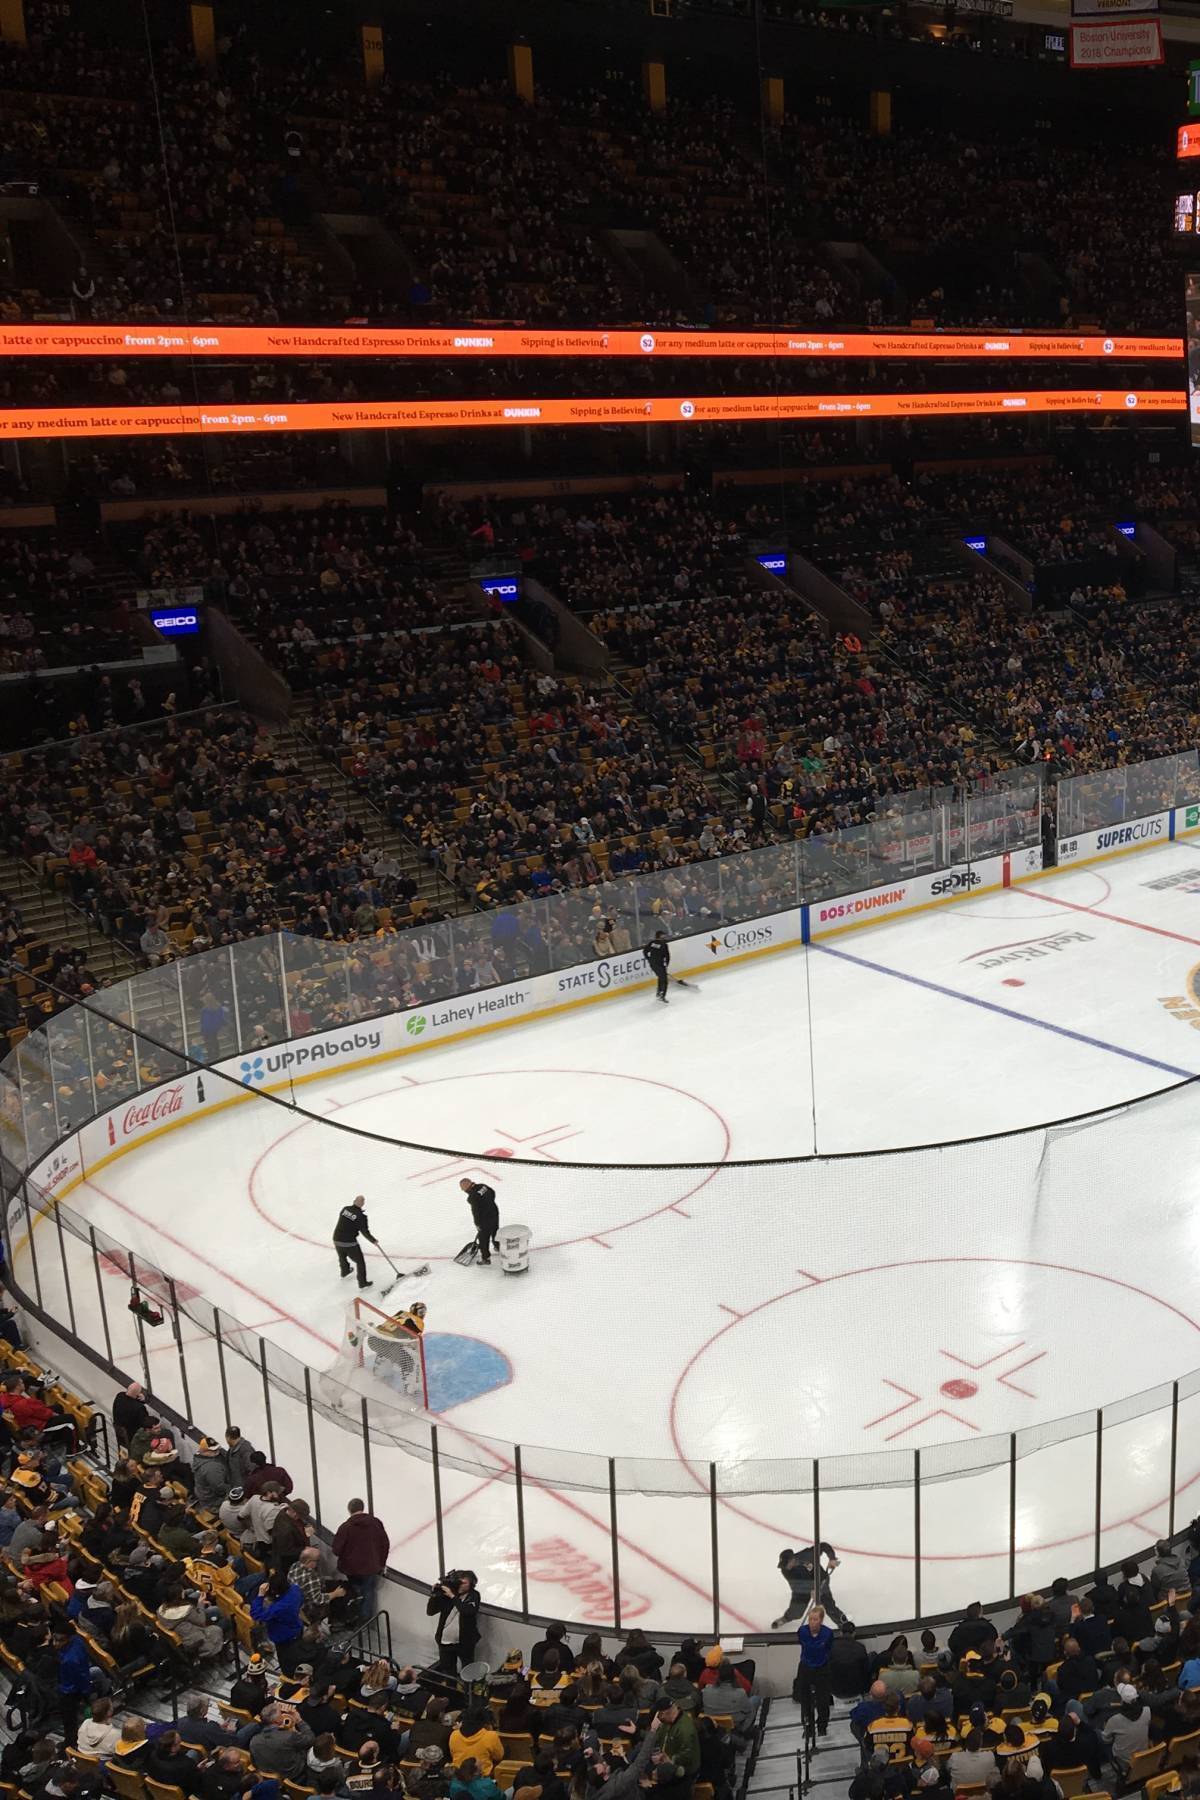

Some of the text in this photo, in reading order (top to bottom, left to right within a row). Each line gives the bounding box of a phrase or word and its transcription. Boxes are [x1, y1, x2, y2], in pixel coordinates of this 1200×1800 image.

[1079, 31, 1108, 44] Boston
[1110, 29, 1150, 43] University
[1104, 45, 1152, 58] Champions
[3, 334, 219, 349] latte or cappuccino from 2pm 6pm
[267, 336, 292, 347] New
[293, 335, 359, 347] Handcrafted
[361, 337, 404, 349] Espresso
[406, 337, 441, 347] Drinks
[442, 338, 452, 347] at
[520, 337, 555, 350] Sipping
[556, 338, 565, 347] is
[12, 413, 288, 430] any medium latte or cappuccino from 2pm 6pm
[153, 615, 197, 628] GEICO
[1096, 818, 1163, 851] SUPERCUTS
[820, 888, 906, 922] BOS DUNKIN'
[722, 925, 773, 951] CROSS
[976, 931, 1097, 970] Red River
[558, 970, 595, 992] STATE
[432, 991, 525, 1028] Lahey Health
[266, 1030, 381, 1074] UPPAbaby
[122, 1083, 185, 1136] Coca-Cola
